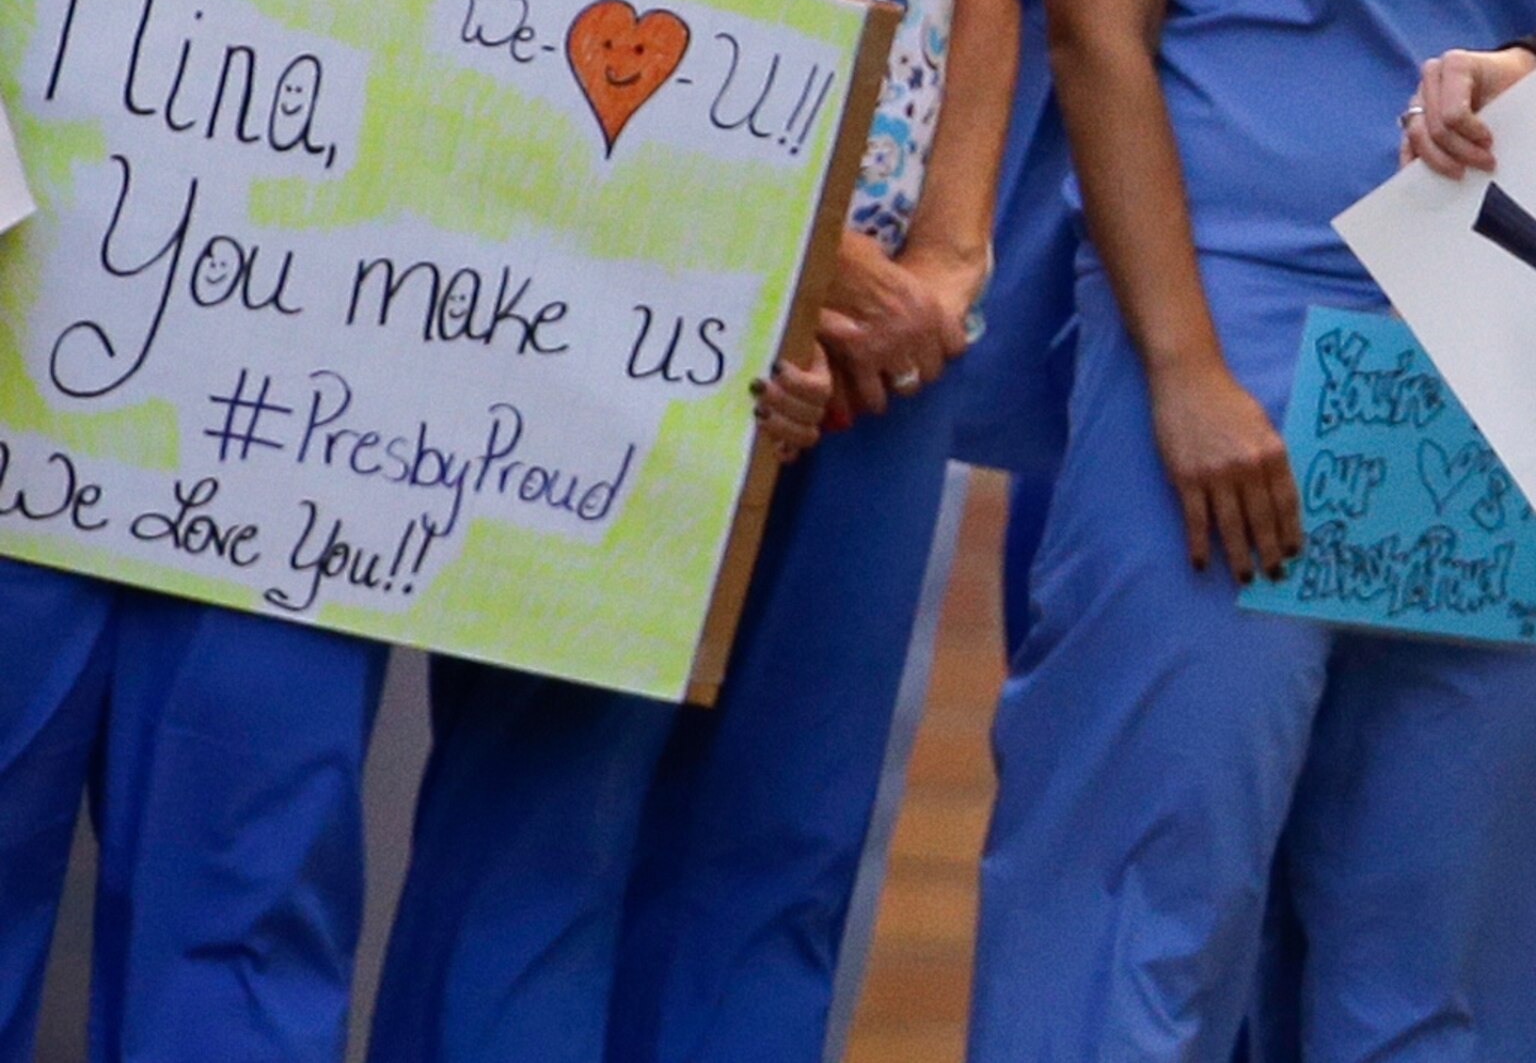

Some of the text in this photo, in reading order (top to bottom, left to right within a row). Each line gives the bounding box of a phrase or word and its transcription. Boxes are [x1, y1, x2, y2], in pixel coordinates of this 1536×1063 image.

[49, 154, 729, 399] You make us
[0, 441, 432, 612] We Love You!!
[204, 368, 637, 537] #PresbyProud
